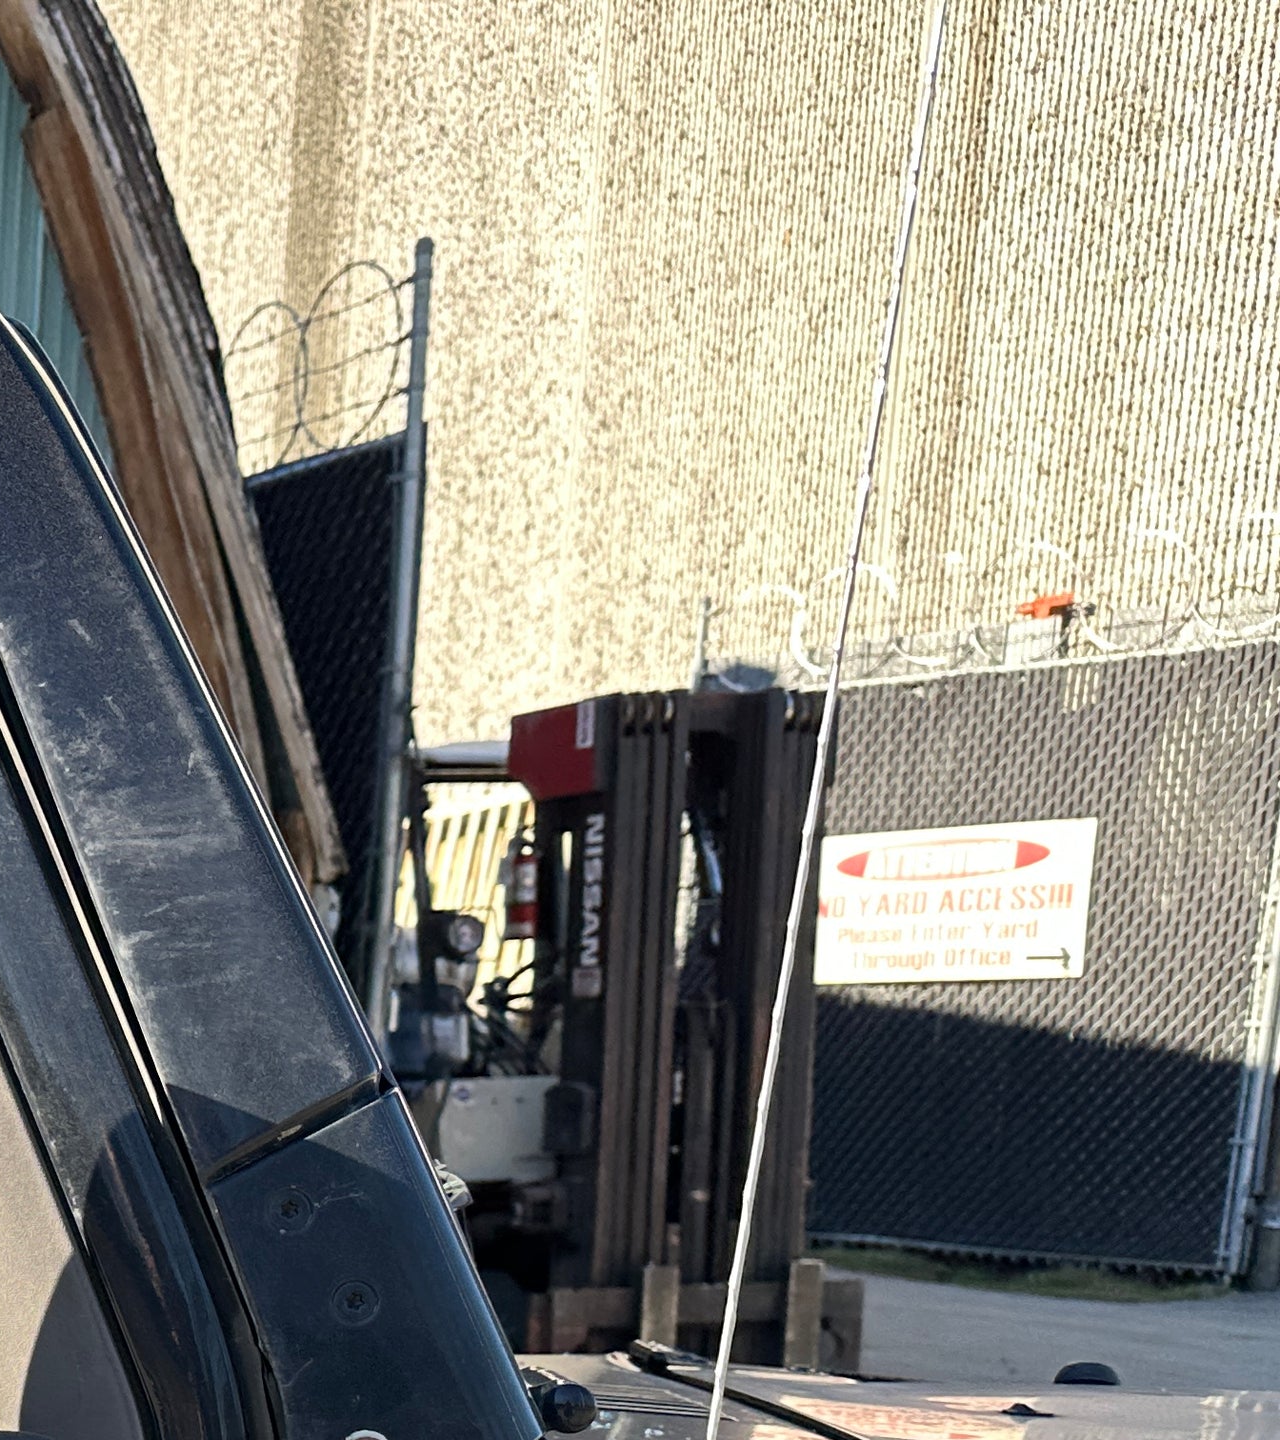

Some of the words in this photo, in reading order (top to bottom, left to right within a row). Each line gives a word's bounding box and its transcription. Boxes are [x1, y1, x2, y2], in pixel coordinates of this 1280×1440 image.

[579, 813, 605, 966] NISSAN
[819, 896, 846, 918] NO
[859, 891, 928, 916] YARD
[837, 926, 902, 944] Please
[912, 921, 972, 941] Enter
[982, 919, 1039, 939] Yard
[853, 951, 935, 971] Through
[943, 947, 1012, 967] Office
